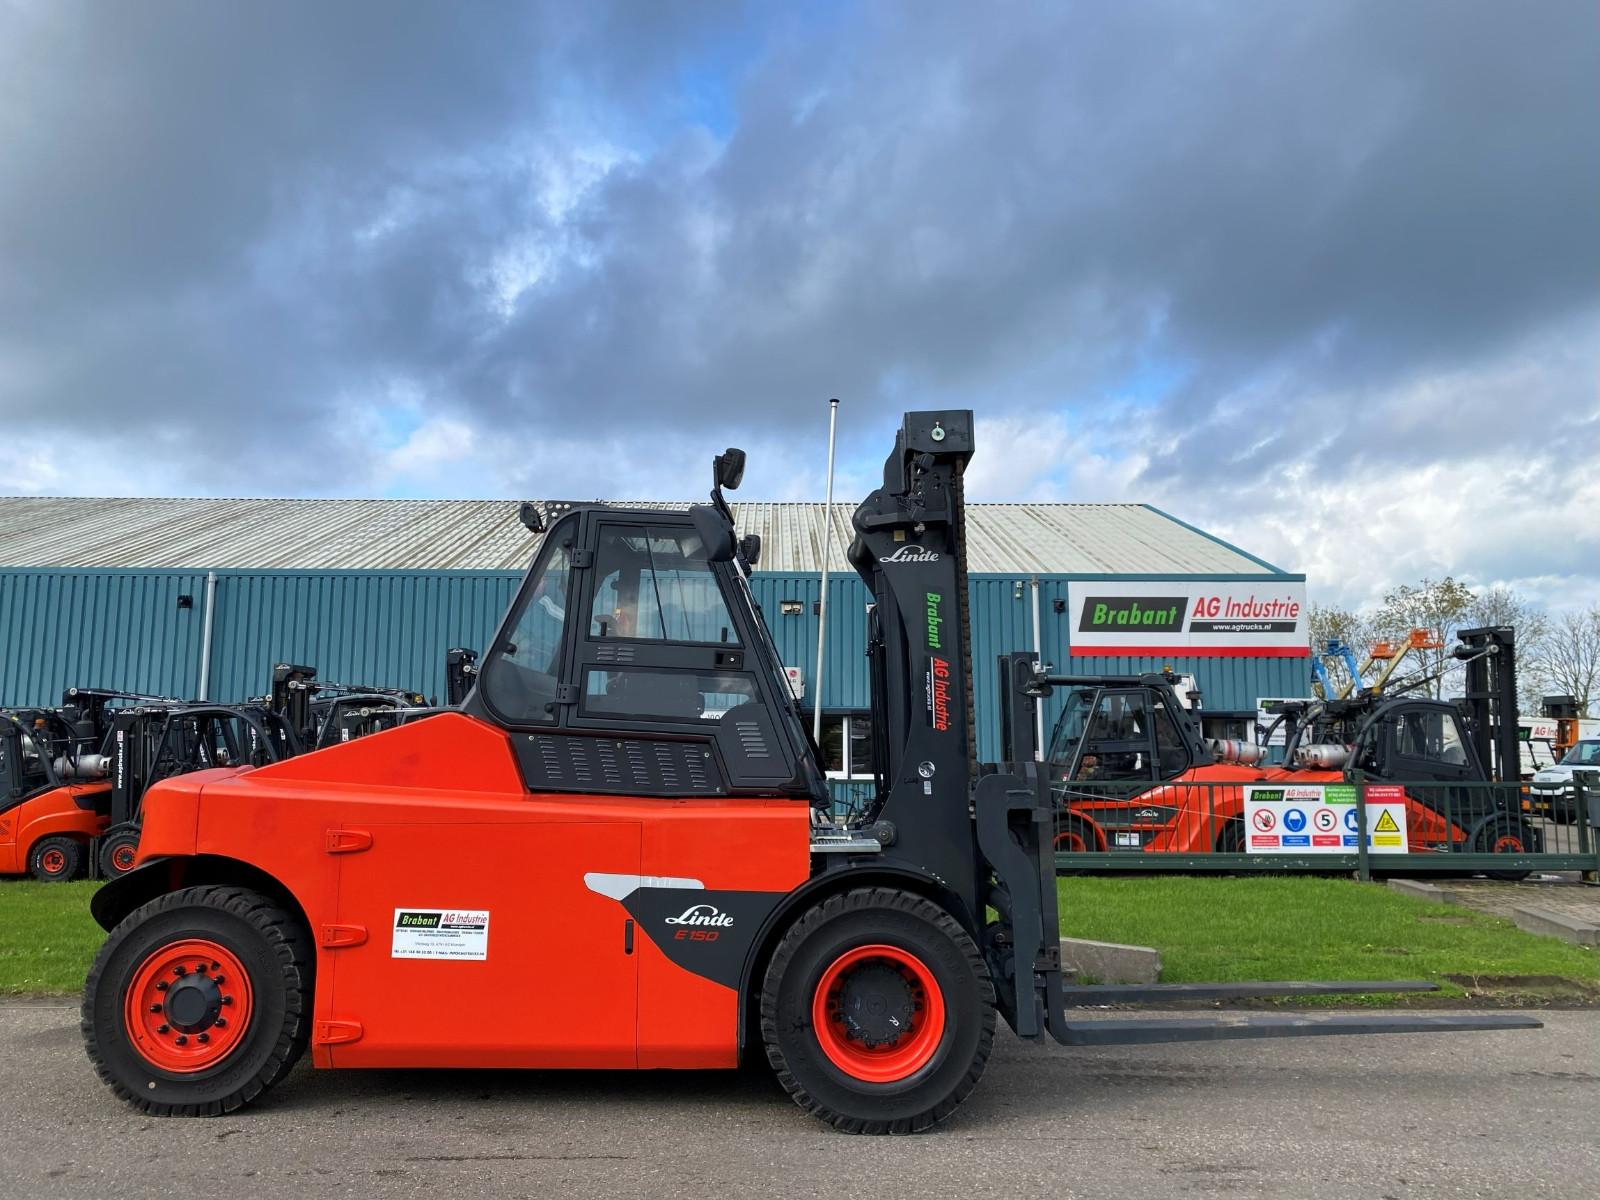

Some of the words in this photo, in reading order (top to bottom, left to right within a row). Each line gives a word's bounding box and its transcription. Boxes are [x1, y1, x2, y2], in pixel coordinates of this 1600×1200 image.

[880, 545, 939, 563] Linde
[1092, 603, 1177, 625] Brabant
[1192, 597, 1221, 618] AG
[1225, 595, 1299, 618] Industrie
[926, 592, 943, 649] Brabant
[1212, 623, 1272, 632] www.agtrucks.nl
[934, 657, 949, 677] AG
[935, 680, 952, 732] Industrie
[1254, 791, 1282, 800] Brabant
[1321, 814, 1331, 827] 5
[402, 914, 438, 925] Brabant
[443, 913, 455, 923] AG
[455, 913, 488, 924] Industrie
[665, 904, 734, 927] Linde
[674, 929, 686, 940] E
[687, 931, 720, 942] 150
